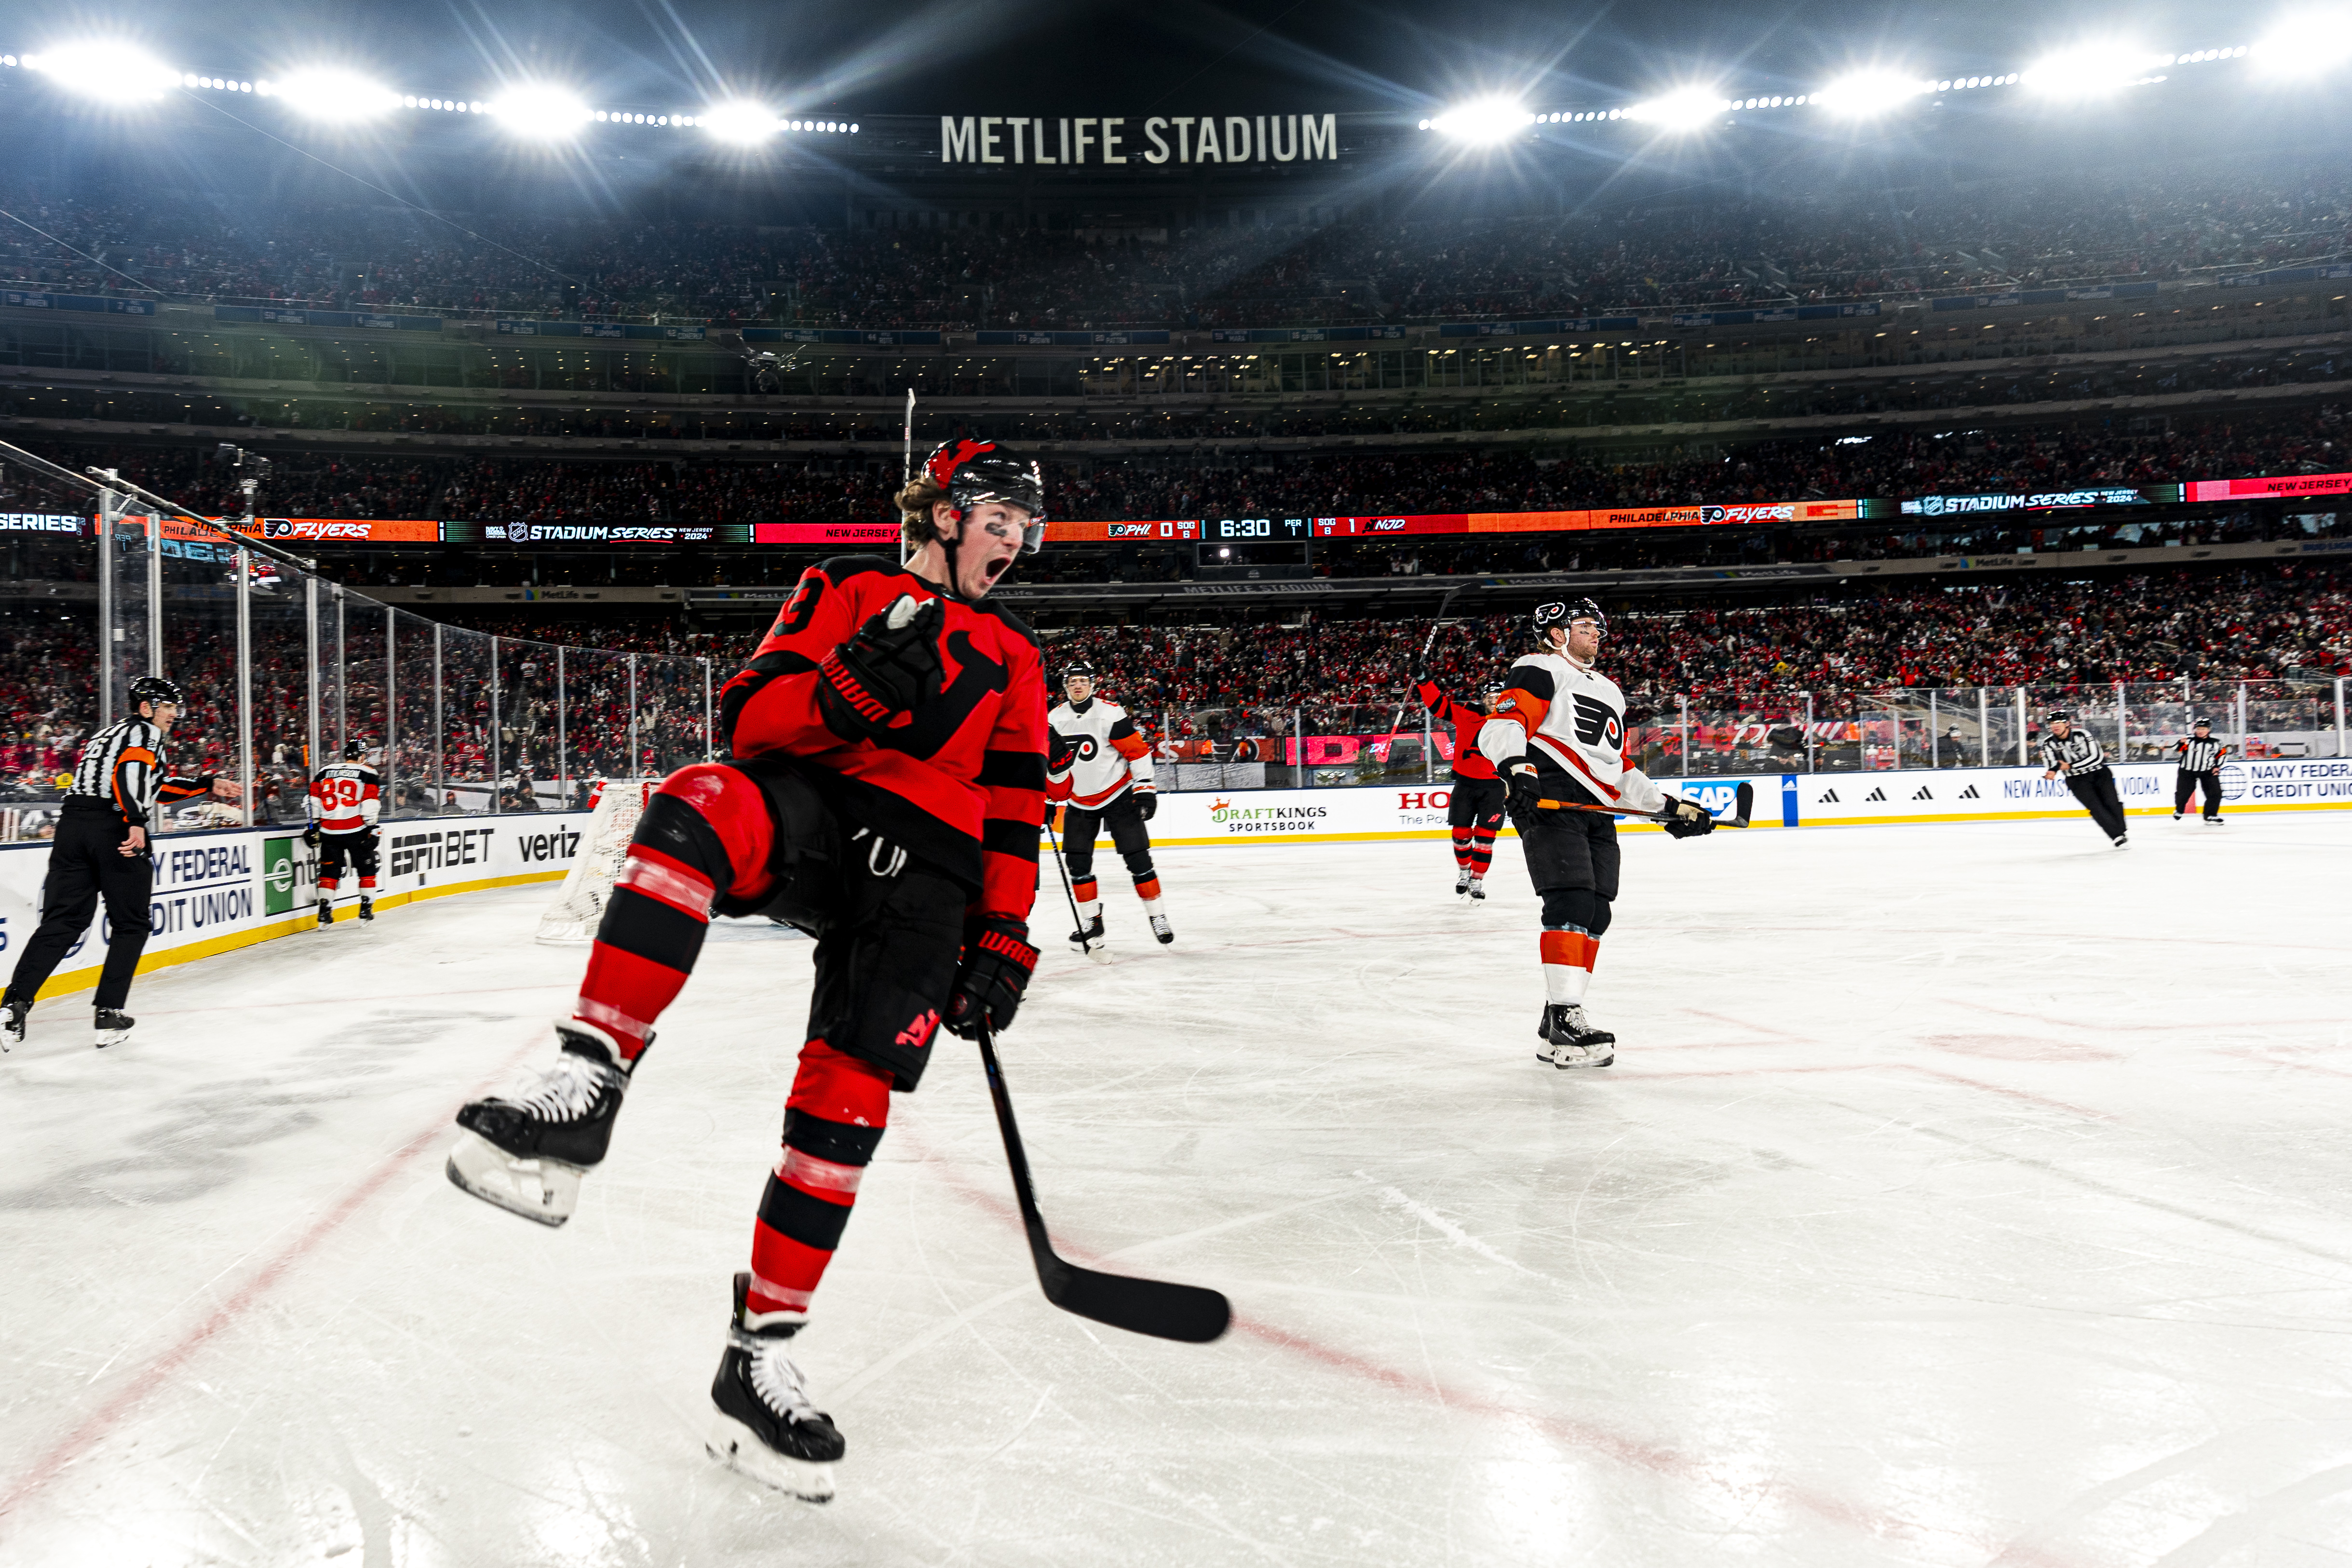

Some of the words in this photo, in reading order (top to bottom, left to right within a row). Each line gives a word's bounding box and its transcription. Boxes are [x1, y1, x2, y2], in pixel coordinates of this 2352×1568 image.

[941, 116, 1127, 163] METLIFE
[1144, 114, 1338, 164] STADIUM
[2268, 483, 2297, 492] NEW
[2299, 479, 2351, 489] JERSEY
[1944, 495, 2025, 513] STADIUM
[2025, 492, 2098, 507] SERIES
[2106, 495, 2132, 503] 2024
[1609, 512, 1699, 523] PHILADELPHIA
[1725, 505, 1795, 524] FLYERS
[1124, 524, 1150, 536] PHI
[1161, 522, 1173, 537] 0
[1220, 519, 1270, 537] 6:30
[1292, 527, 1296, 536] 1
[1324, 527, 1331, 535] 8
[1349, 518, 1355, 533] 1
[1373, 518, 1406, 530] NJD
[293, 523, 372, 541] FLYERS
[513, 527, 524, 538] NHL
[529, 525, 608, 540] STADIUM
[608, 527, 677, 540] SERIES
[826, 529, 851, 537] NEW
[852, 528, 895, 537] JERSEY
[1183, 530, 1190, 539] 6
[541, 591, 579, 599] MetLife
[1183, 585, 1254, 594] METLIFE
[1258, 583, 1335, 592] STADIUM
[773, 577, 825, 637] 3
[2251, 765, 2296, 779] NAVY
[321, 778, 360, 811] 89
[2004, 780, 2032, 798] NEW
[2121, 776, 2160, 795] VODKA
[2252, 784, 2312, 798] CREDIT
[1682, 786, 1735, 811] SAP
[1212, 807, 1327, 823] DRAFTKINGS
[1398, 815, 1423, 825] The
[1230, 821, 1315, 832] SPORTSBOOK
[519, 824, 581, 863] veriz
[390, 832, 442, 878] ESPN
[446, 828, 495, 867] BET
[172, 845, 251, 884] FEDERAL
[191, 887, 253, 928] UNION
